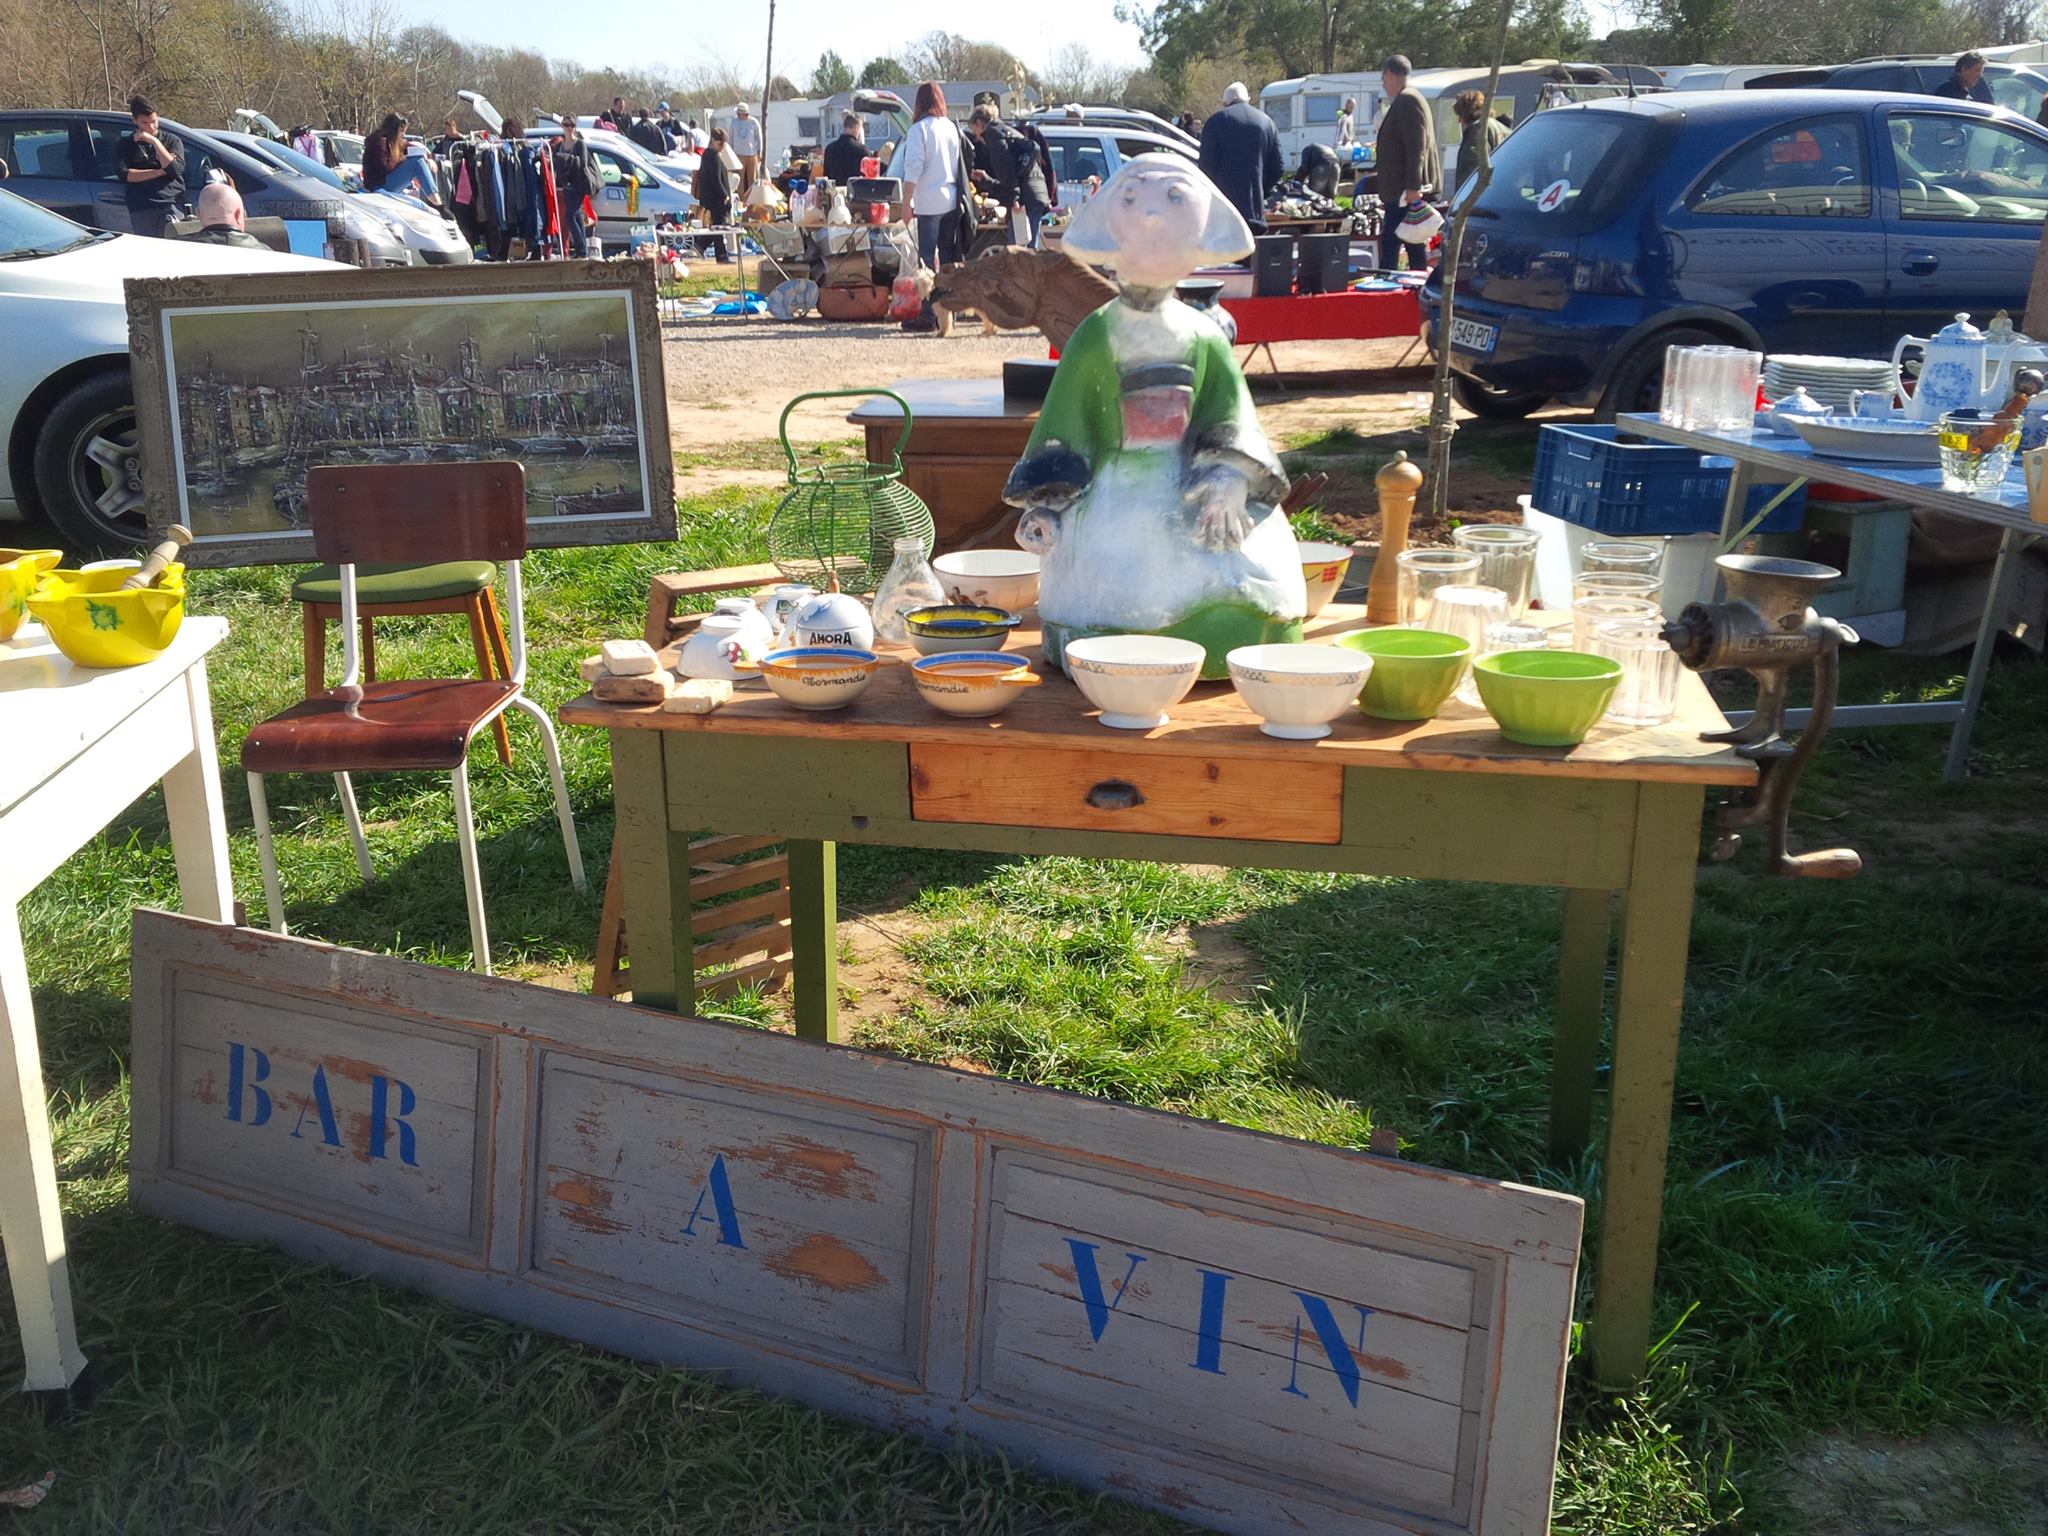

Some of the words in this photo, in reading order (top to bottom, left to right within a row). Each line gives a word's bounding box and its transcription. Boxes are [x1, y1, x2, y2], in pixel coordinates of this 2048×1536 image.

[1541, 184, 1563, 207] A
[223, 1041, 420, 1167] BAR
[679, 1152, 749, 1250] A
[1062, 1237, 1376, 1409] VIN
